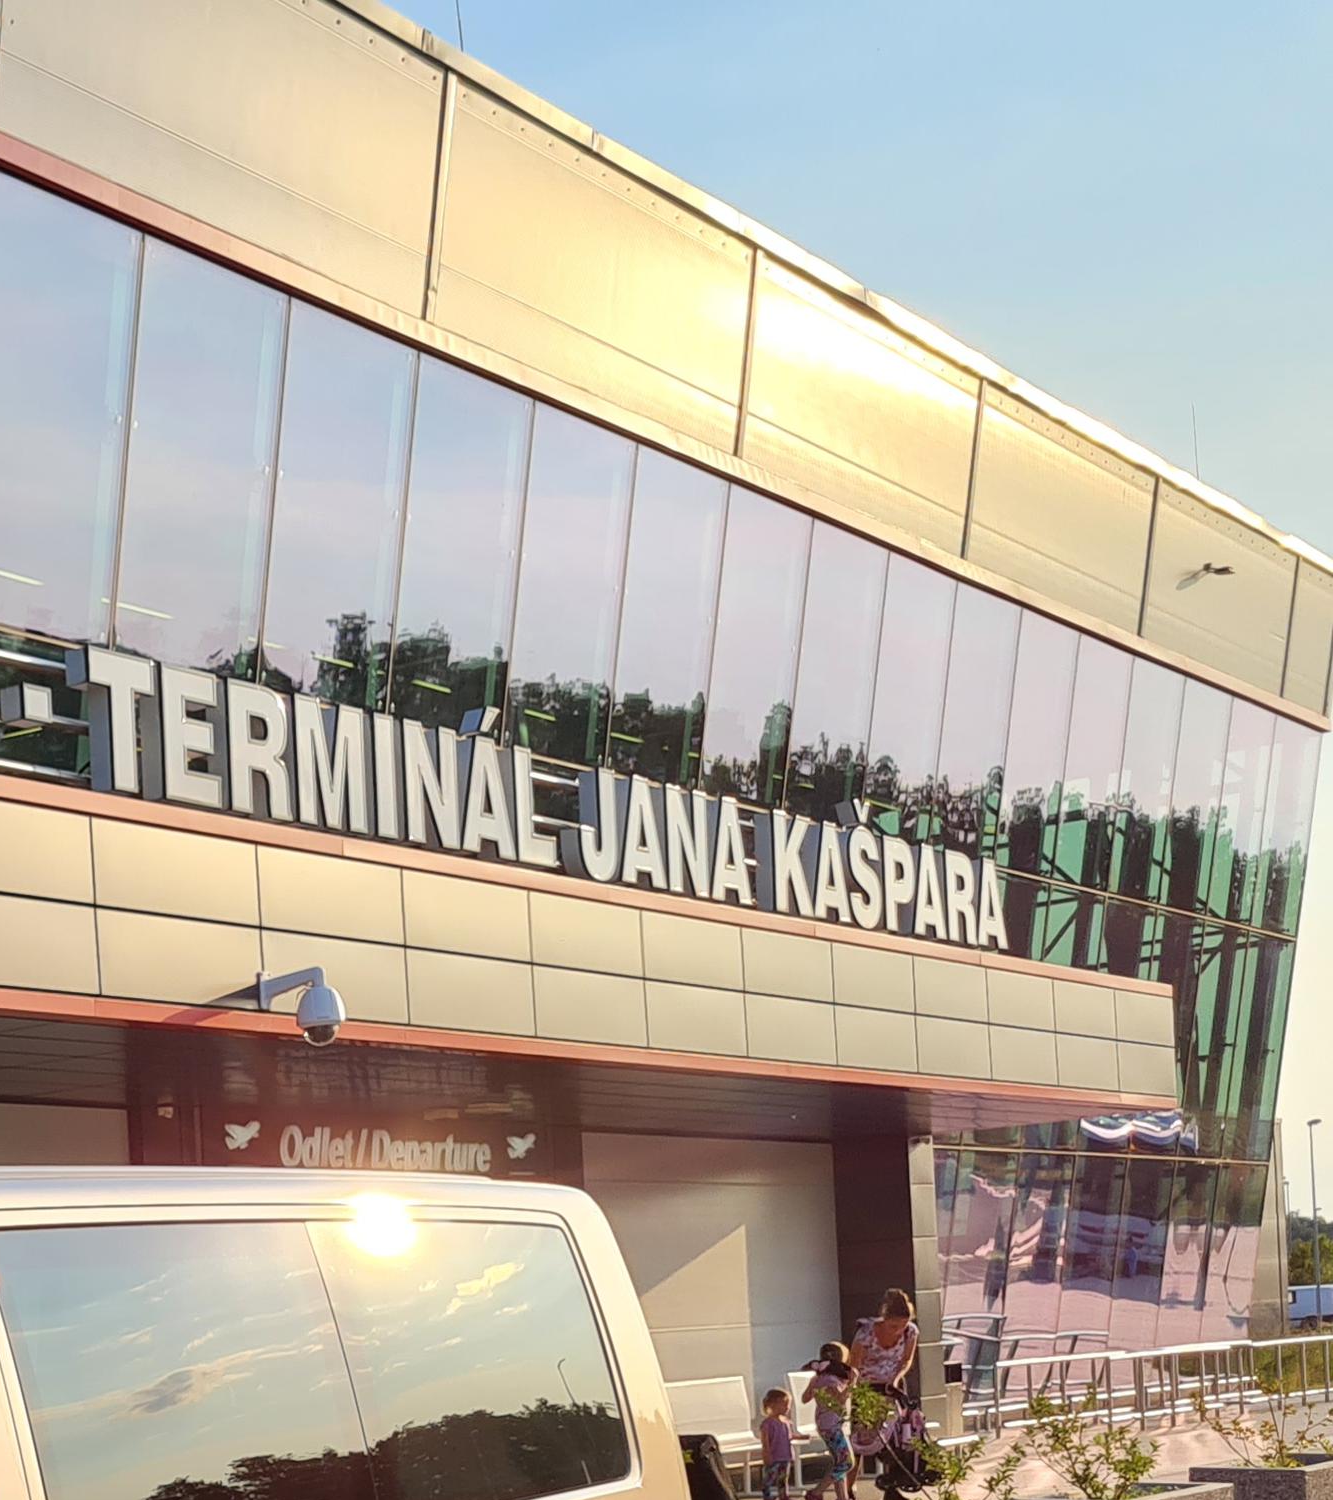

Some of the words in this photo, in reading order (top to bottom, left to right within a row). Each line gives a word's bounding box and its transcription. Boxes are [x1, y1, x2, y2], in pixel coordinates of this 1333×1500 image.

[83, 643, 561, 870] TERMINÁL
[571, 765, 756, 907] JANA
[771, 798, 1009, 951] KAŠPARA
[279, 1124, 355, 1169] Odlet
[371, 1128, 492, 1173] Departure
